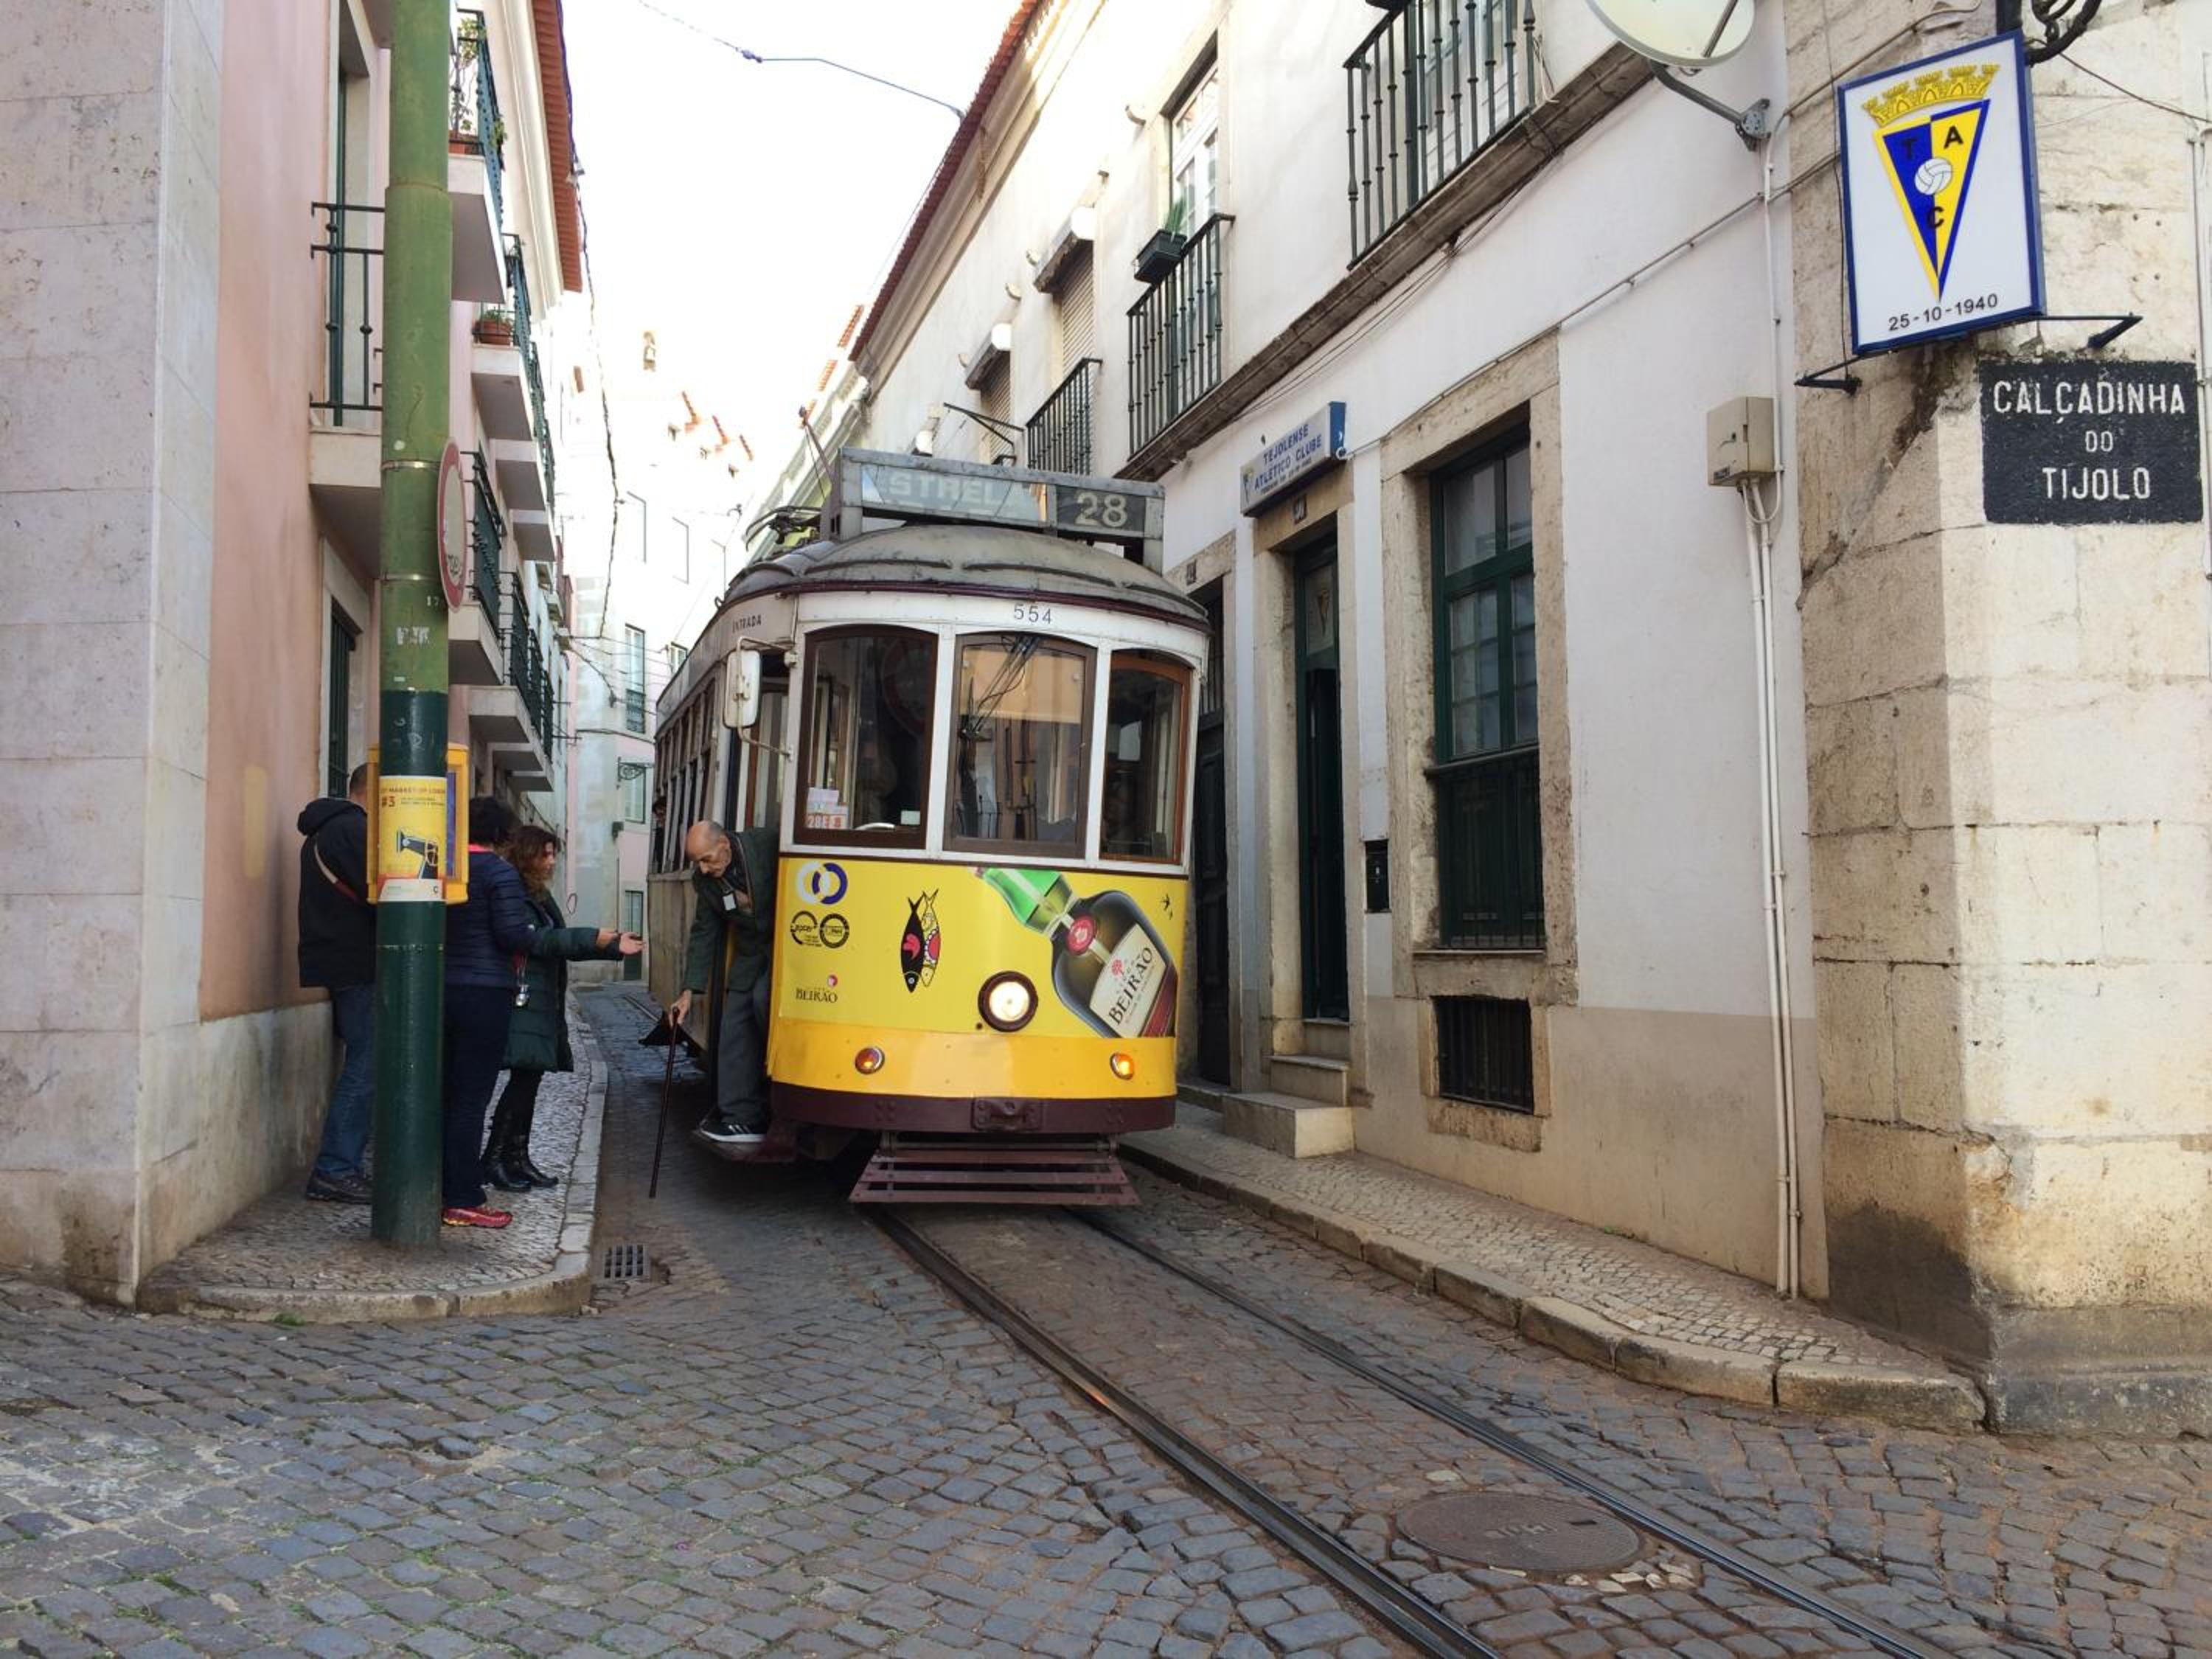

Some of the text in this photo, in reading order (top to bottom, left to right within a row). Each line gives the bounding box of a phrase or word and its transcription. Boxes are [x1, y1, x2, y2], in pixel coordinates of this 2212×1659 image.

[1901, 125, 1964, 161] T A
[1926, 206, 1945, 229] C
[1888, 292, 1999, 332] 25-10-1940
[1992, 380, 2186, 425] CALÇADINHA
[1295, 434, 1322, 462] CLUBE
[2084, 430, 2115, 453] DO
[2042, 466, 2152, 501] TIJOLO
[1074, 490, 1128, 528] 28
[1014, 602, 1051, 625] 554
[1108, 947, 1152, 1025] BEIRÃO
